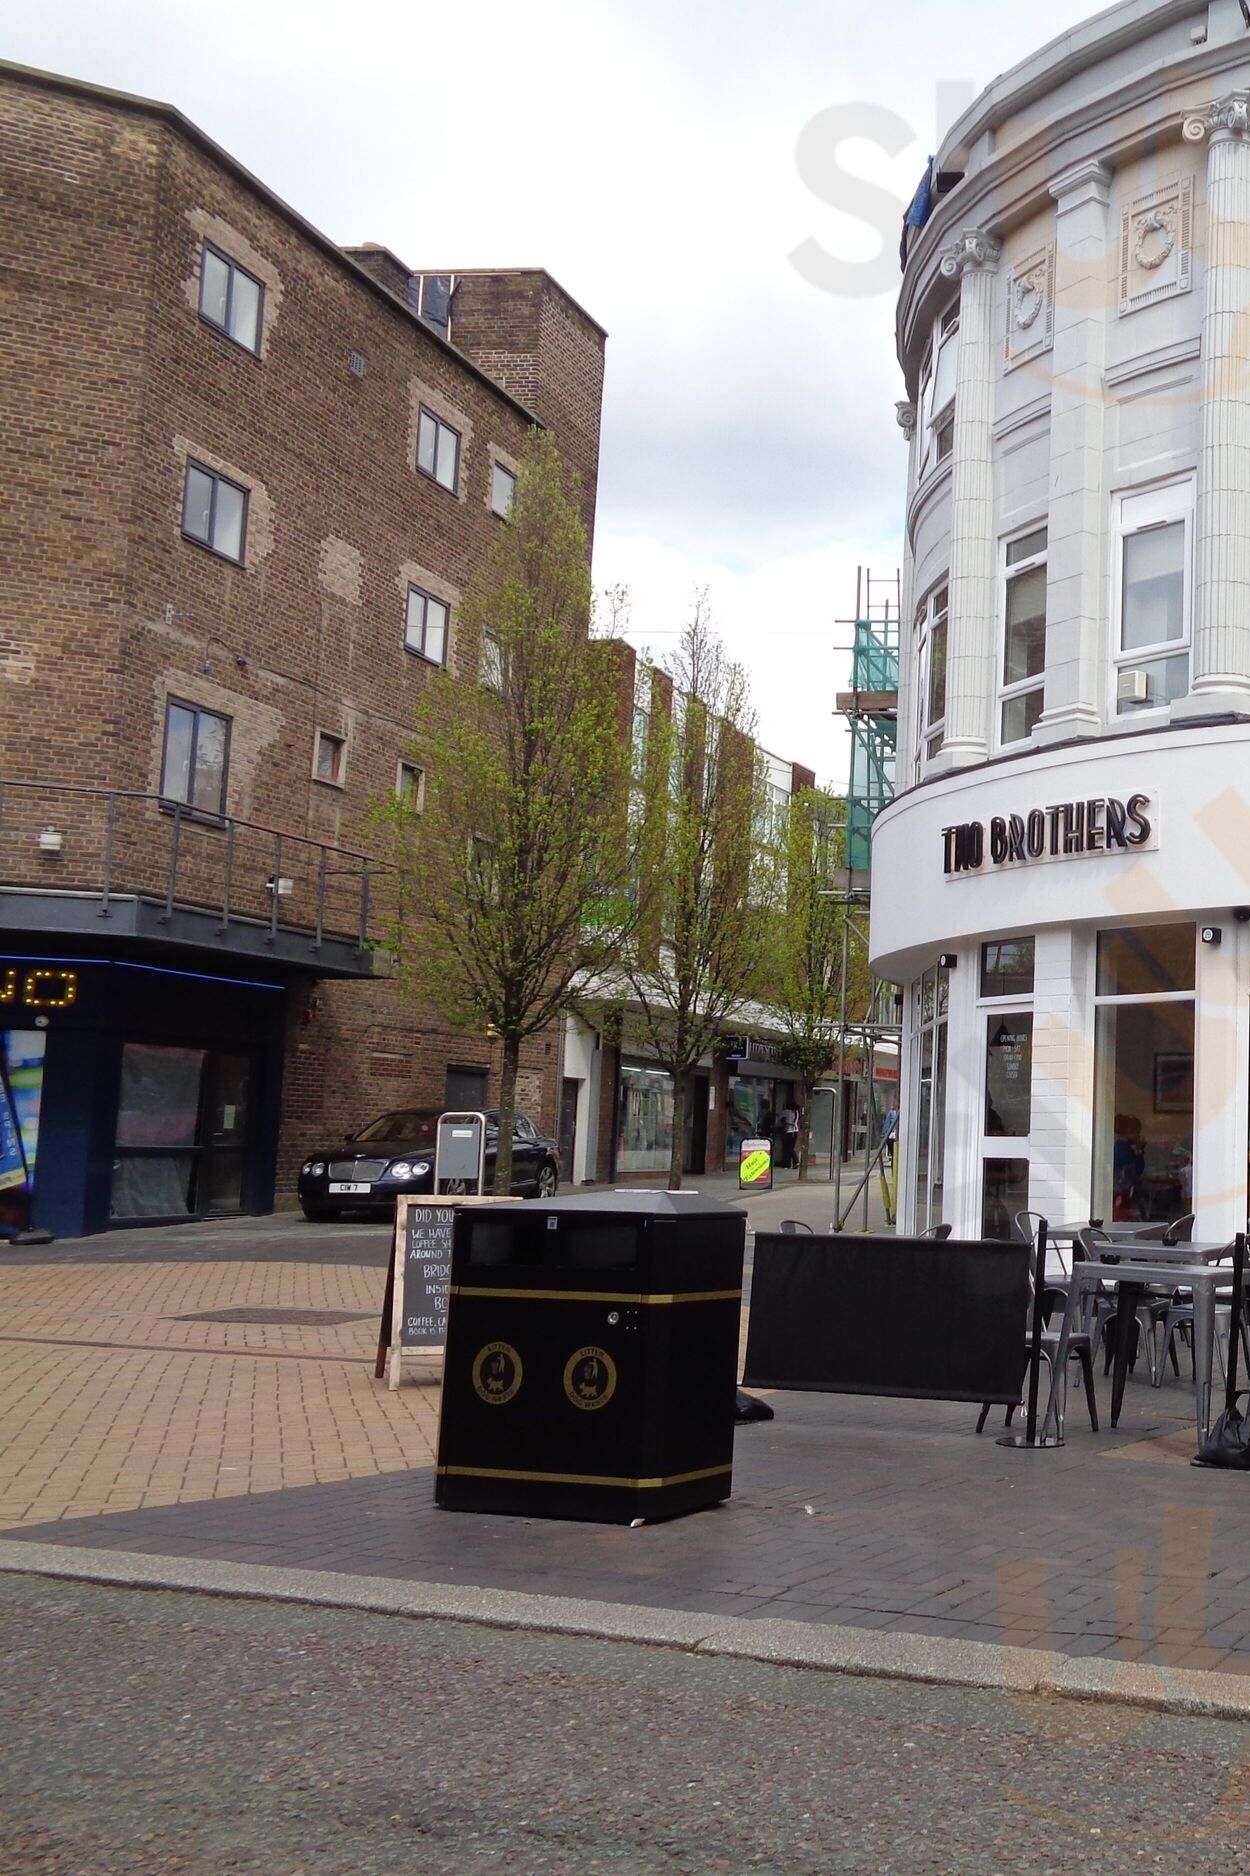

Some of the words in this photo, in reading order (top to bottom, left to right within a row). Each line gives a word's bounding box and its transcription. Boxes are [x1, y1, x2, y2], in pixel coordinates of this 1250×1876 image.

[941, 821, 983, 874] TWO
[990, 793, 1151, 865] BROTHERS
[415, 1208, 432, 1223] DID
[435, 1208, 455, 1223] YOU
[412, 1228, 425, 1239] WE
[428, 1227, 451, 1239] HAVE
[412, 1239, 437, 1249] COFFEE
[410, 1249, 442, 1260] AROUND
